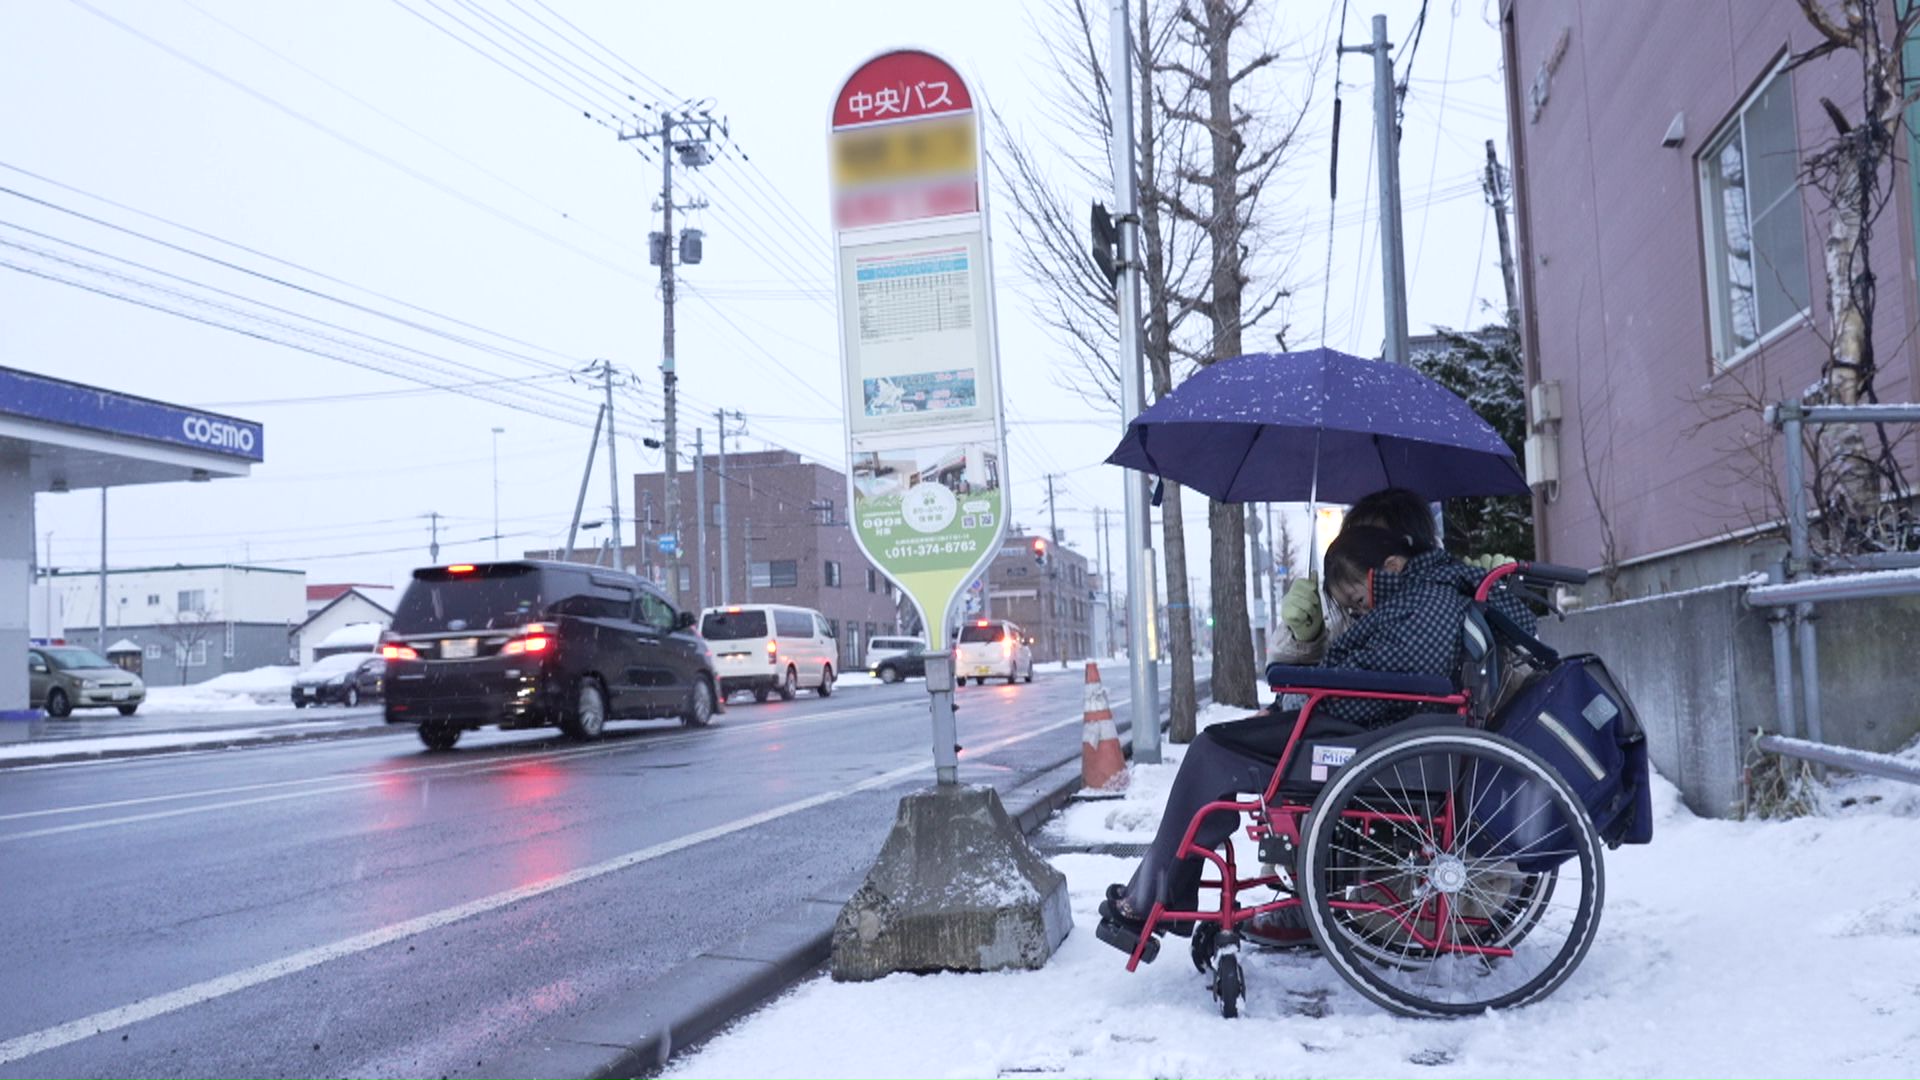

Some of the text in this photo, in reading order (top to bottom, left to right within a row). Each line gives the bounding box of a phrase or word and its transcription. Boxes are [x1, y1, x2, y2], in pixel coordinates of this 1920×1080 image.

[849, 81, 953, 118] 中央バス
[183, 416, 254, 452] COSMO
[891, 540, 976, 558] 011-374-6762
